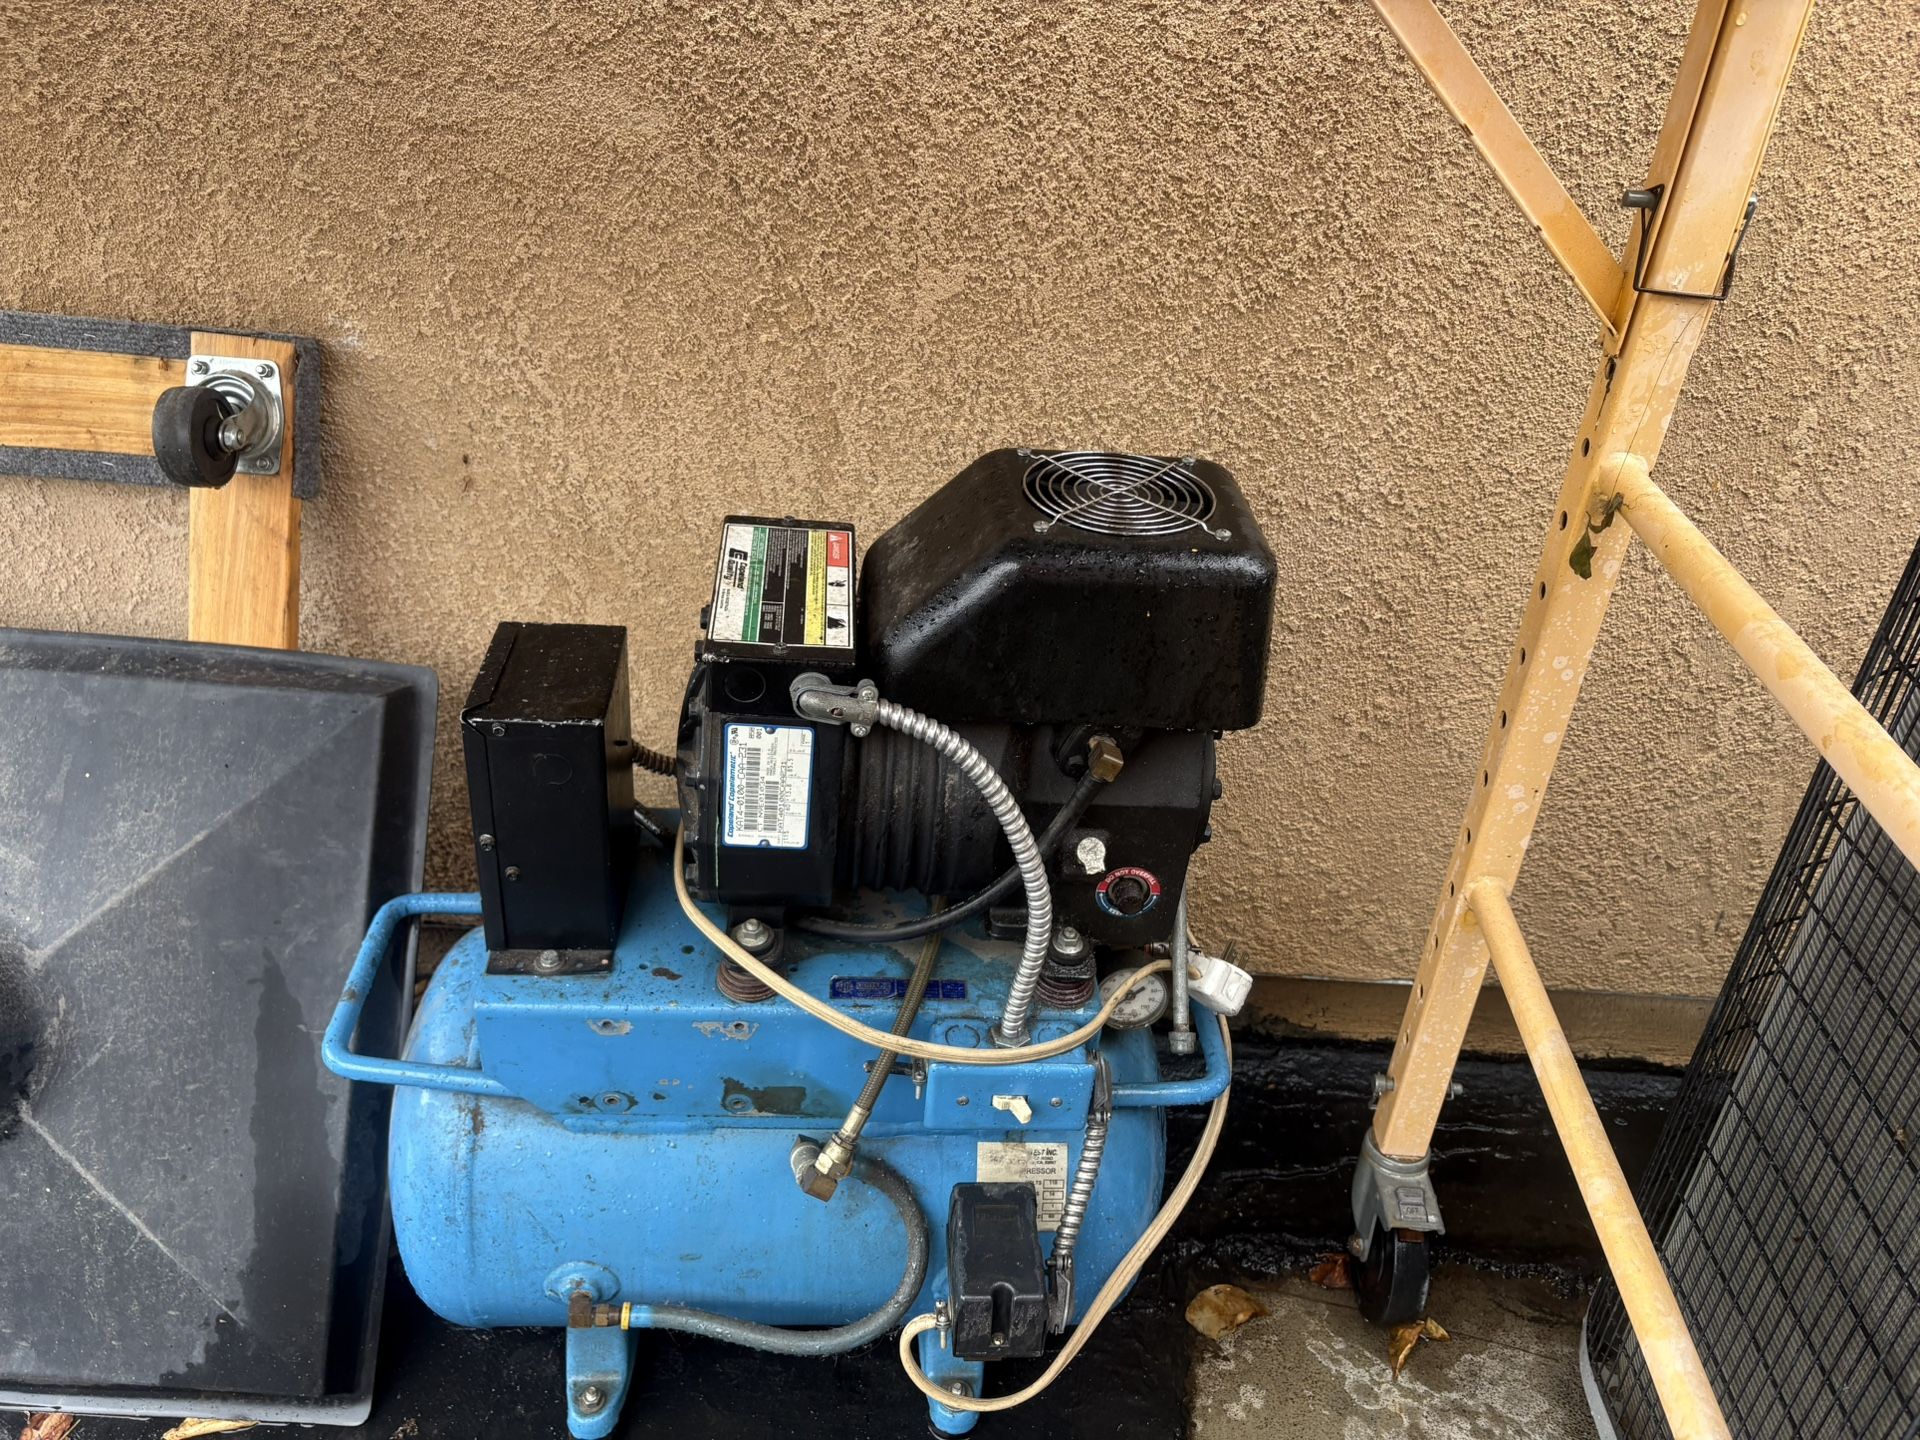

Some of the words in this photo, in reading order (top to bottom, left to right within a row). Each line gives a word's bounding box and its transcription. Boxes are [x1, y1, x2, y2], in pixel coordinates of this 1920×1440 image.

[723, 559, 735, 580] Quality
[737, 562, 747, 590] Copeland
[728, 752, 737, 801] Copelametic
[736, 743, 747, 831] KAT4-0100-CAA-231
[727, 801, 735, 838] Copeland
[1105, 874, 1115, 883] DO
[1115, 869, 1129, 877] NOT
[1025, 1167, 1057, 1175] RESSOR
